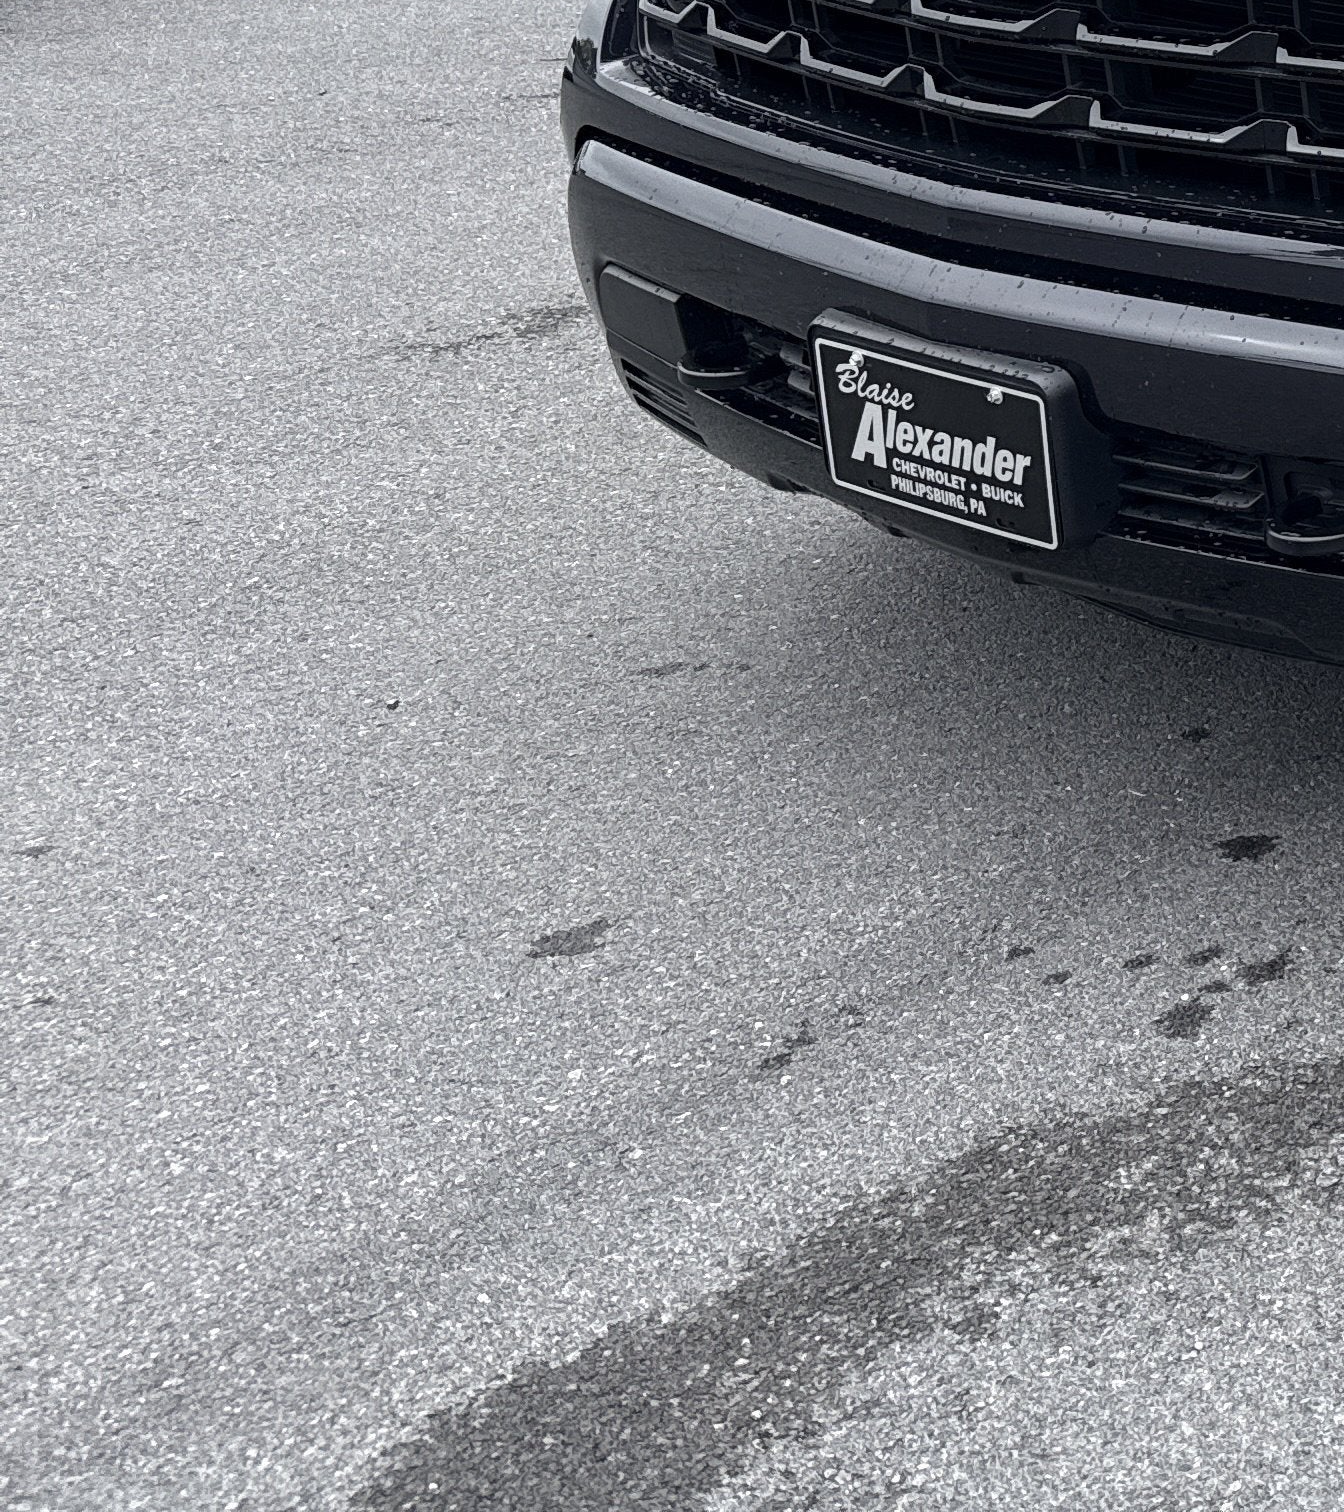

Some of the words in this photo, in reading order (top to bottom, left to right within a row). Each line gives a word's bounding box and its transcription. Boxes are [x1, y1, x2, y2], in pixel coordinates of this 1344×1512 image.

[835, 363, 915, 411] Blaise
[851, 402, 1031, 486] Alexander
[891, 474, 968, 514] PHILIPSBURG,
[970, 497, 987, 517] PA
[892, 457, 967, 491] CHEVROLET
[982, 483, 1024, 507] BUICK
